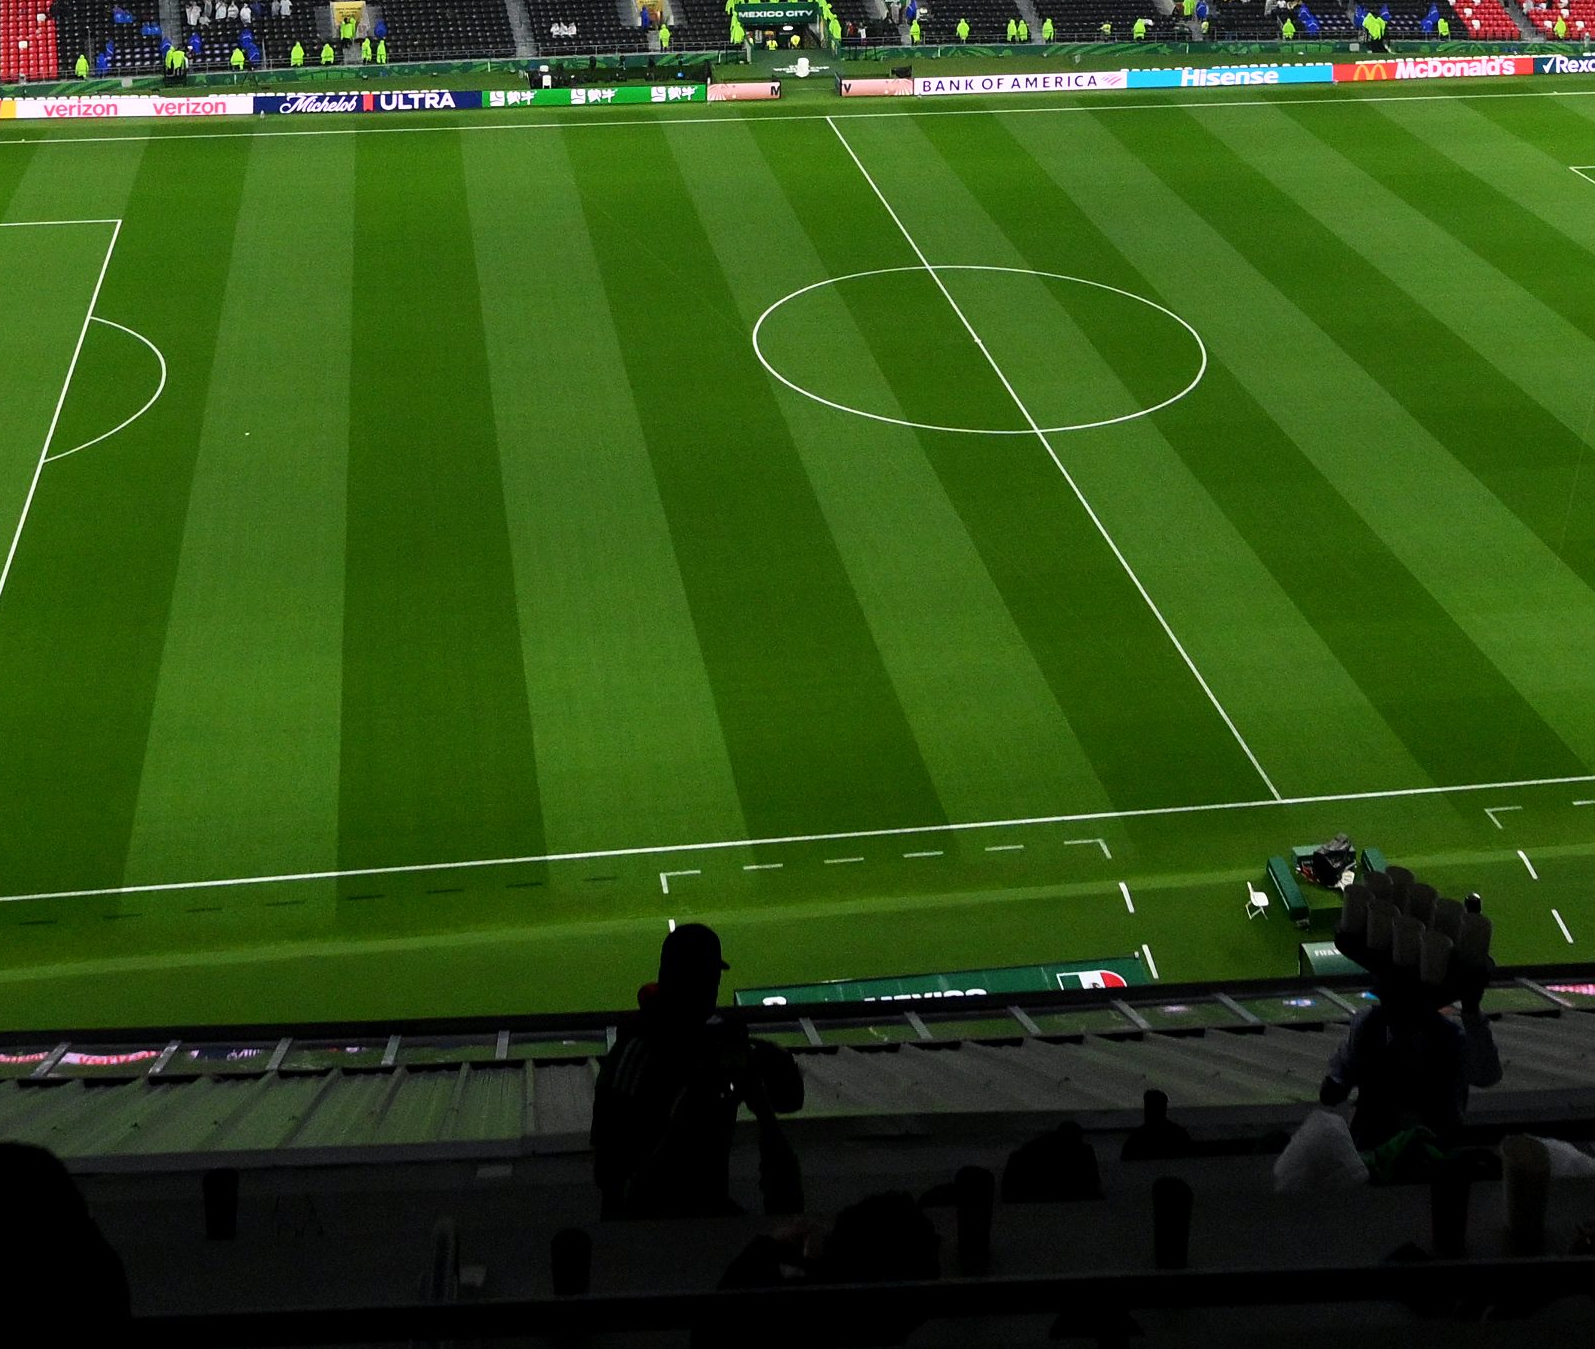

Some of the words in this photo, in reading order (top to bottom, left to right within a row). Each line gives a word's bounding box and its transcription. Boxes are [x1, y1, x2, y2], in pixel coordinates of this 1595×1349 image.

[738, 10, 784, 18] MEXICO
[785, 9, 814, 17] CITY
[1181, 68, 1279, 87] Hisense
[1395, 58, 1515, 79] McDonald's
[923, 78, 974, 93] BANK
[982, 77, 1005, 91] OF
[1011, 74, 1098, 91] AMERICA
[44, 100, 118, 117] verizon
[153, 98, 226, 116] verizon
[280, 93, 357, 114] Michelob
[380, 92, 456, 109] ULTRA
